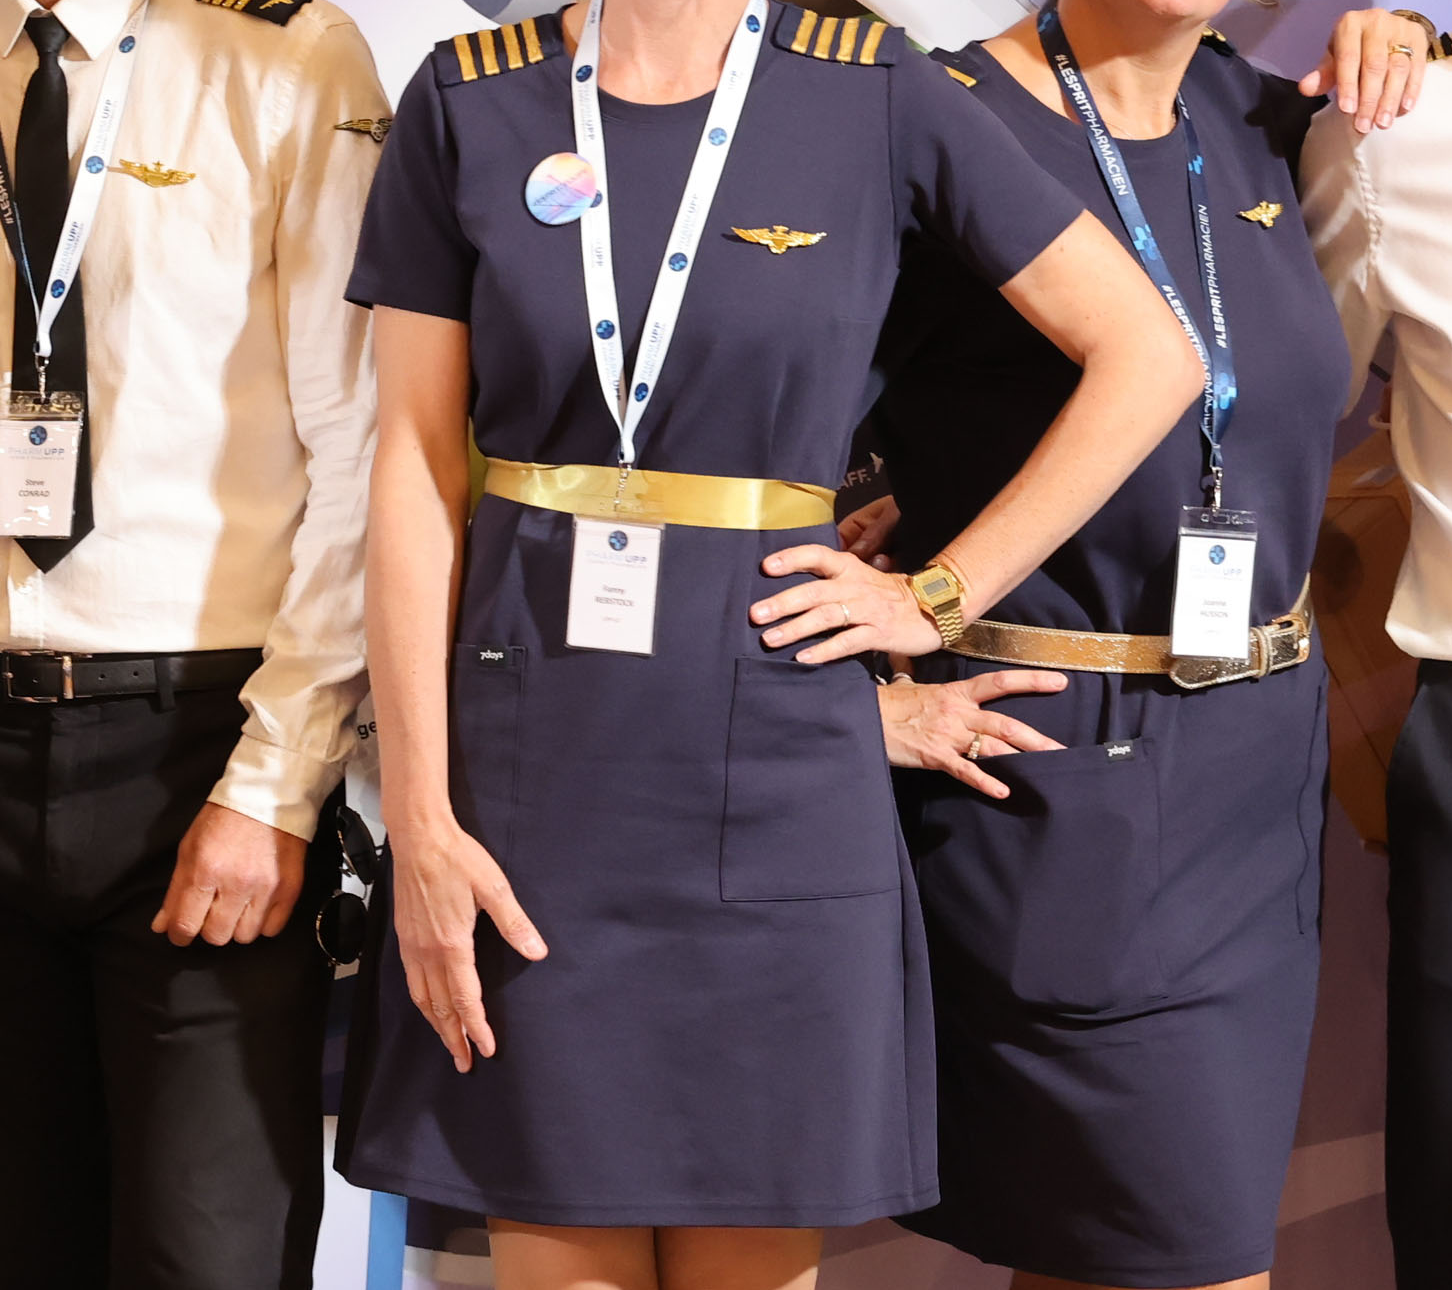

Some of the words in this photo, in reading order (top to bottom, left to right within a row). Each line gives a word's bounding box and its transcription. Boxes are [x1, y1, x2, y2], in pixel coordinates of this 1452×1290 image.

[1054, 53, 1128, 196] #LESPRITPHARMACIEN
[1198, 204, 1227, 348] #LESPRITPHARMACIEN
[479, 649, 504, 661] 7days
